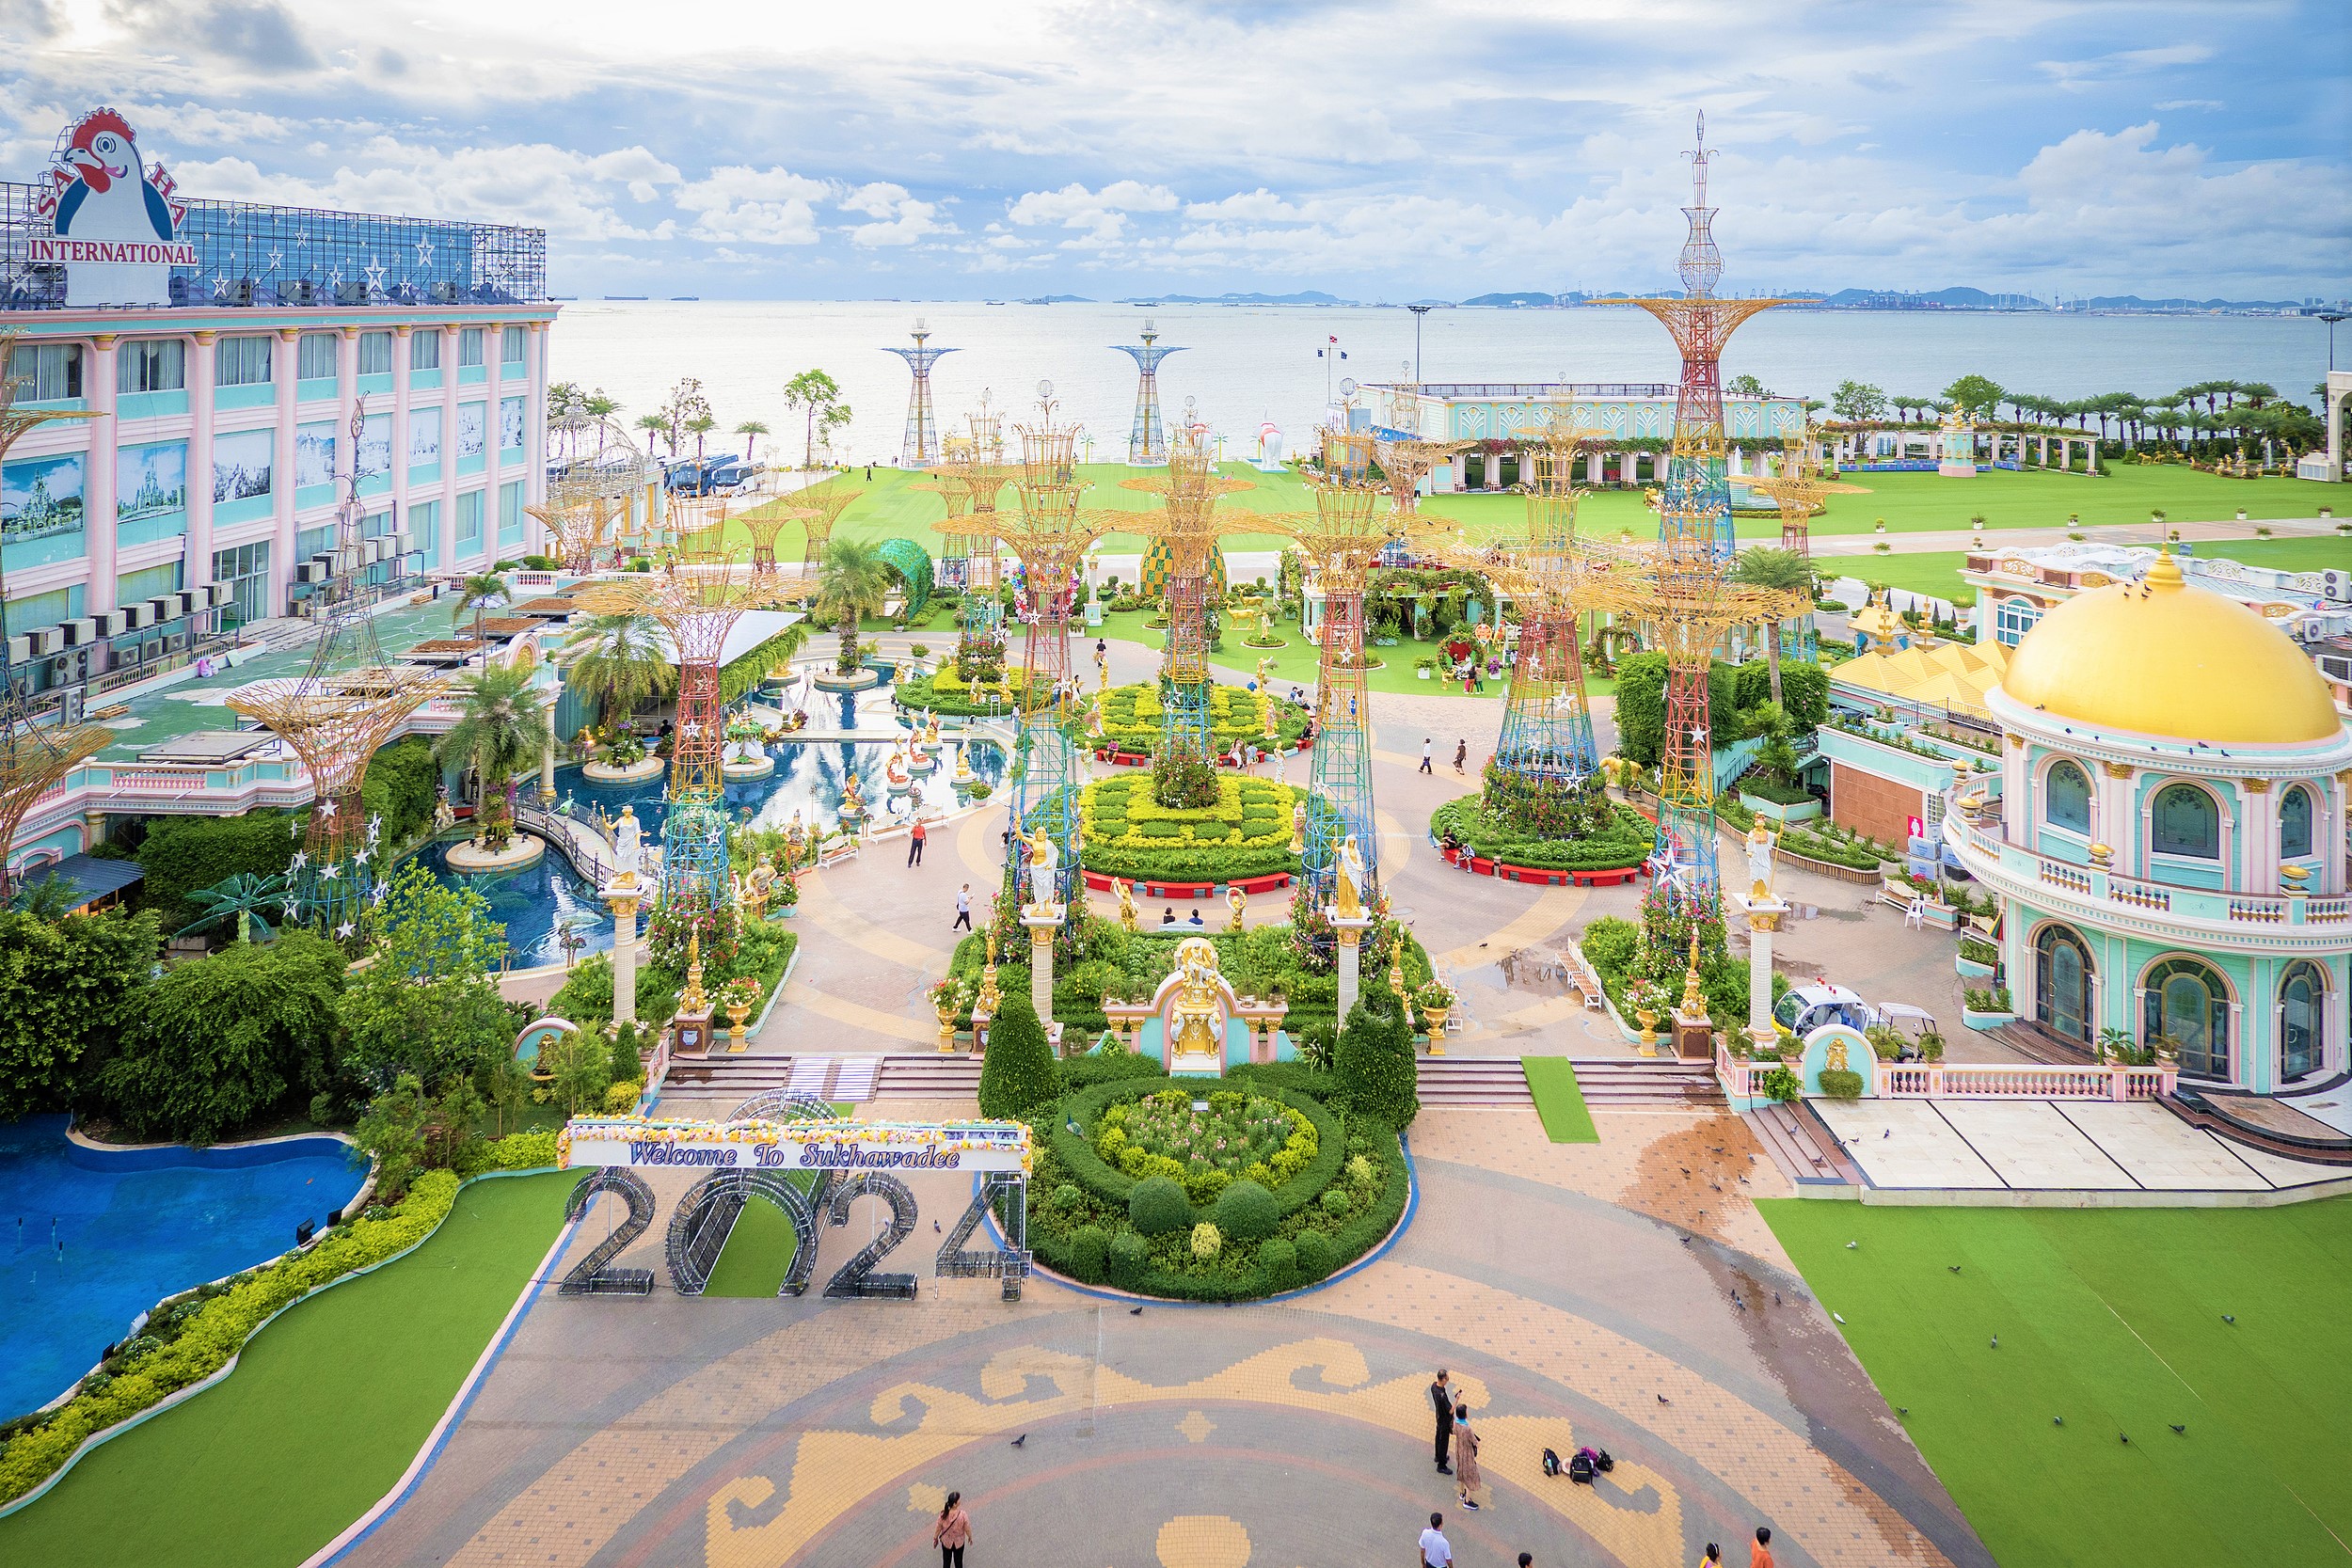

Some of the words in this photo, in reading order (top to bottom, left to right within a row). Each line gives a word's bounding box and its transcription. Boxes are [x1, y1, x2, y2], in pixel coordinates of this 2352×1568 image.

[30, 239, 198, 264] INTERNATIONAL
[629, 1141, 738, 1166] Welcome
[754, 1143, 785, 1167] To
[799, 1143, 961, 1169] Sukhawadee
[558, 1164, 1033, 1302] 2024
